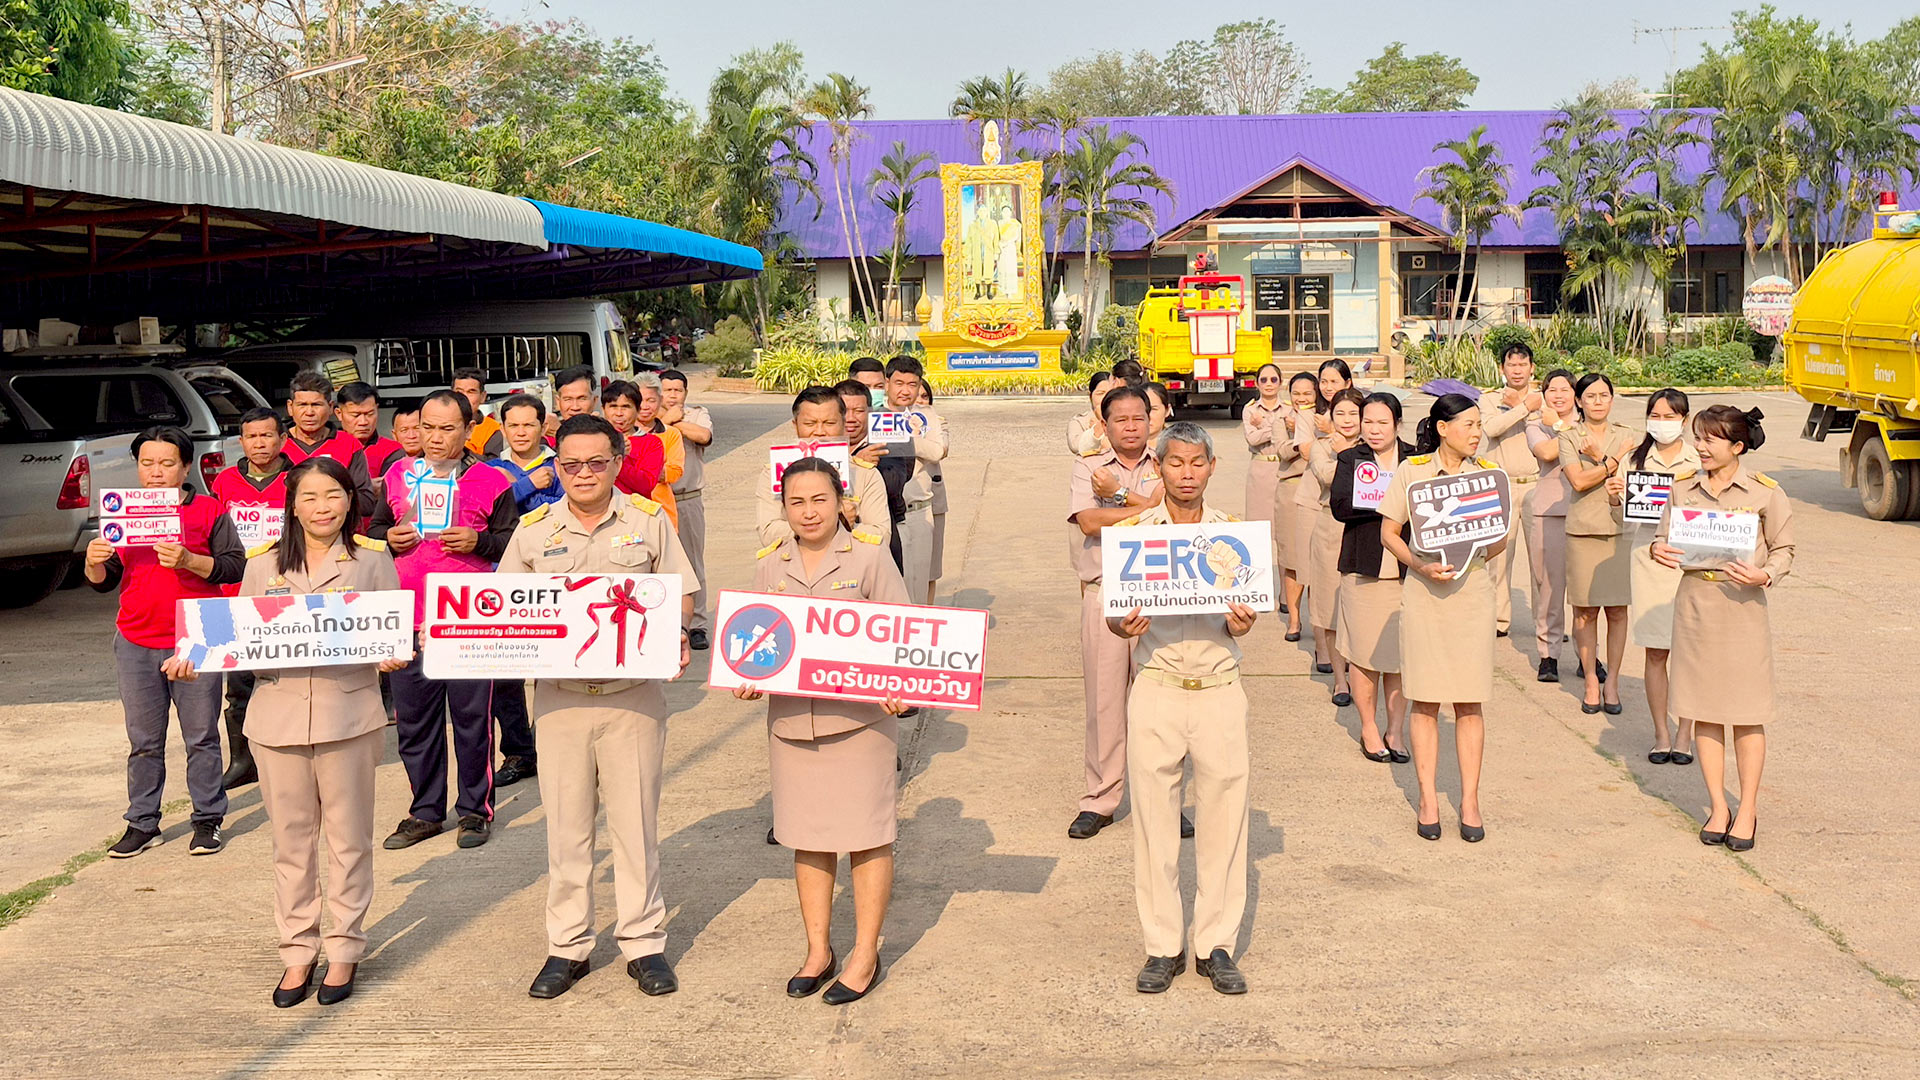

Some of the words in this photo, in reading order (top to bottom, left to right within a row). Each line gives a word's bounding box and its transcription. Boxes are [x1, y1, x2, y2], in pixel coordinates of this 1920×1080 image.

[125, 490, 141, 500] NO
[143, 490, 167, 500] GIFT
[1412, 475, 1497, 503] ต่อต้าน
[424, 493, 445, 508] NO
[126, 520, 142, 529] NO
[143, 520, 168, 529] GIFT
[237, 511, 260, 522] NO
[1421, 515, 1504, 540] คอร์รัปชัน
[1119, 535, 1251, 588] ZERO
[1120, 580, 1198, 592] TOLERANCE
[510, 589, 562, 605] GIFT
[510, 608, 561, 618] POLICY
[805, 606, 861, 637] NO
[866, 610, 948, 647] GIFT
[894, 646, 980, 671] POLICY
[811, 666, 971, 700] งดรับของขวัญ
